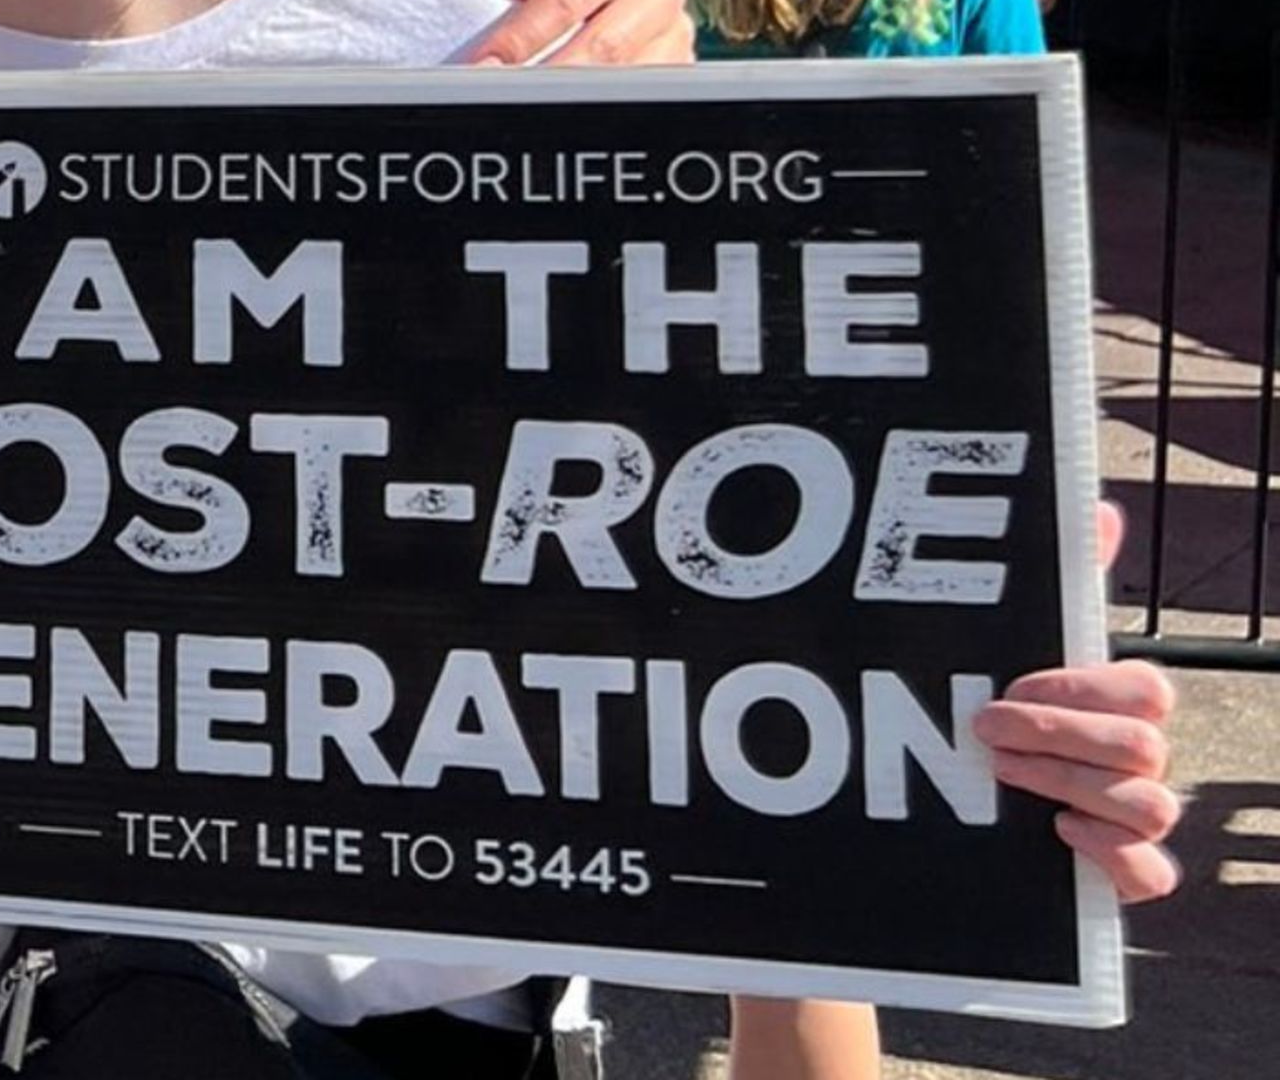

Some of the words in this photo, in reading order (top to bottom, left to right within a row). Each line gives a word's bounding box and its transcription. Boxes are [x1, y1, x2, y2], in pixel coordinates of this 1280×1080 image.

[58, 150, 824, 204] STUDENTSFORLIFE.ORG
[14, 237, 345, 366] AM
[463, 240, 930, 378] THE
[116, 812, 238, 865] TEXT
[254, 822, 364, 874] LIFE
[380, 832, 455, 881] TO
[474, 838, 652, 896] 53445
